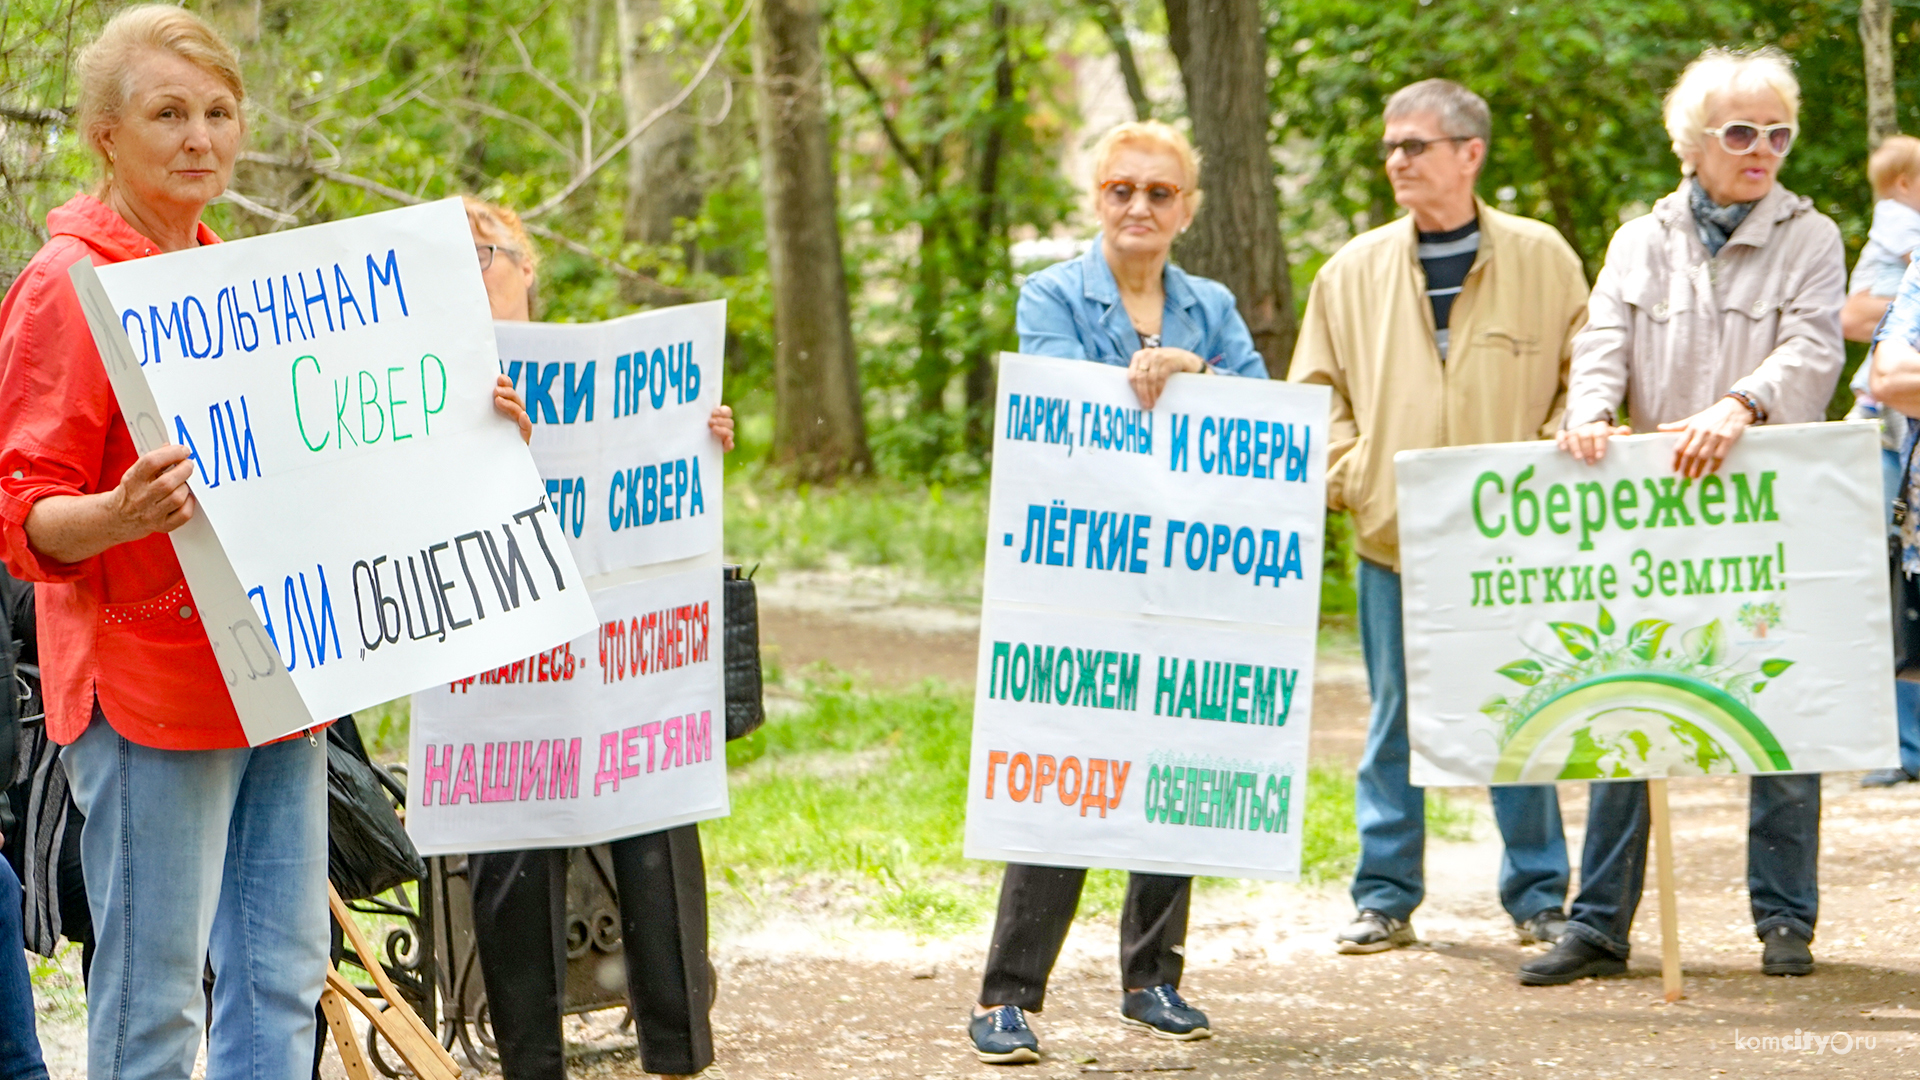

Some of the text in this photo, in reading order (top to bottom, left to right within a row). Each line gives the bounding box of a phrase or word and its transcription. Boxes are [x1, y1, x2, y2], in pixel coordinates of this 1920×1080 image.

[613, 341, 701, 419] ПРОЧЬ
[1006, 393, 1310, 483] ПАРКИ, ГАЗОНЫ И СКВЕРЫ
[608, 456, 704, 532] СКВЕРА
[1472, 465, 1780, 551] Сбережем
[1020, 499, 1151, 574] ЛЁГКИЕ
[1163, 519, 1303, 588] ГОРОДА
[1471, 542, 1786, 607] лёгкие Земли!
[598, 619, 626, 684] ЧТО
[630, 601, 709, 676] ОСТАНЕТСЯ
[989, 641, 1298, 727] ПОМОЖЕМ НАШЕМУ
[423, 711, 711, 807] НАШИМ ДЕТЯМ
[986, 751, 1291, 832] ГОРОДУ ОЗЕЛЕНИТЬСЯ
